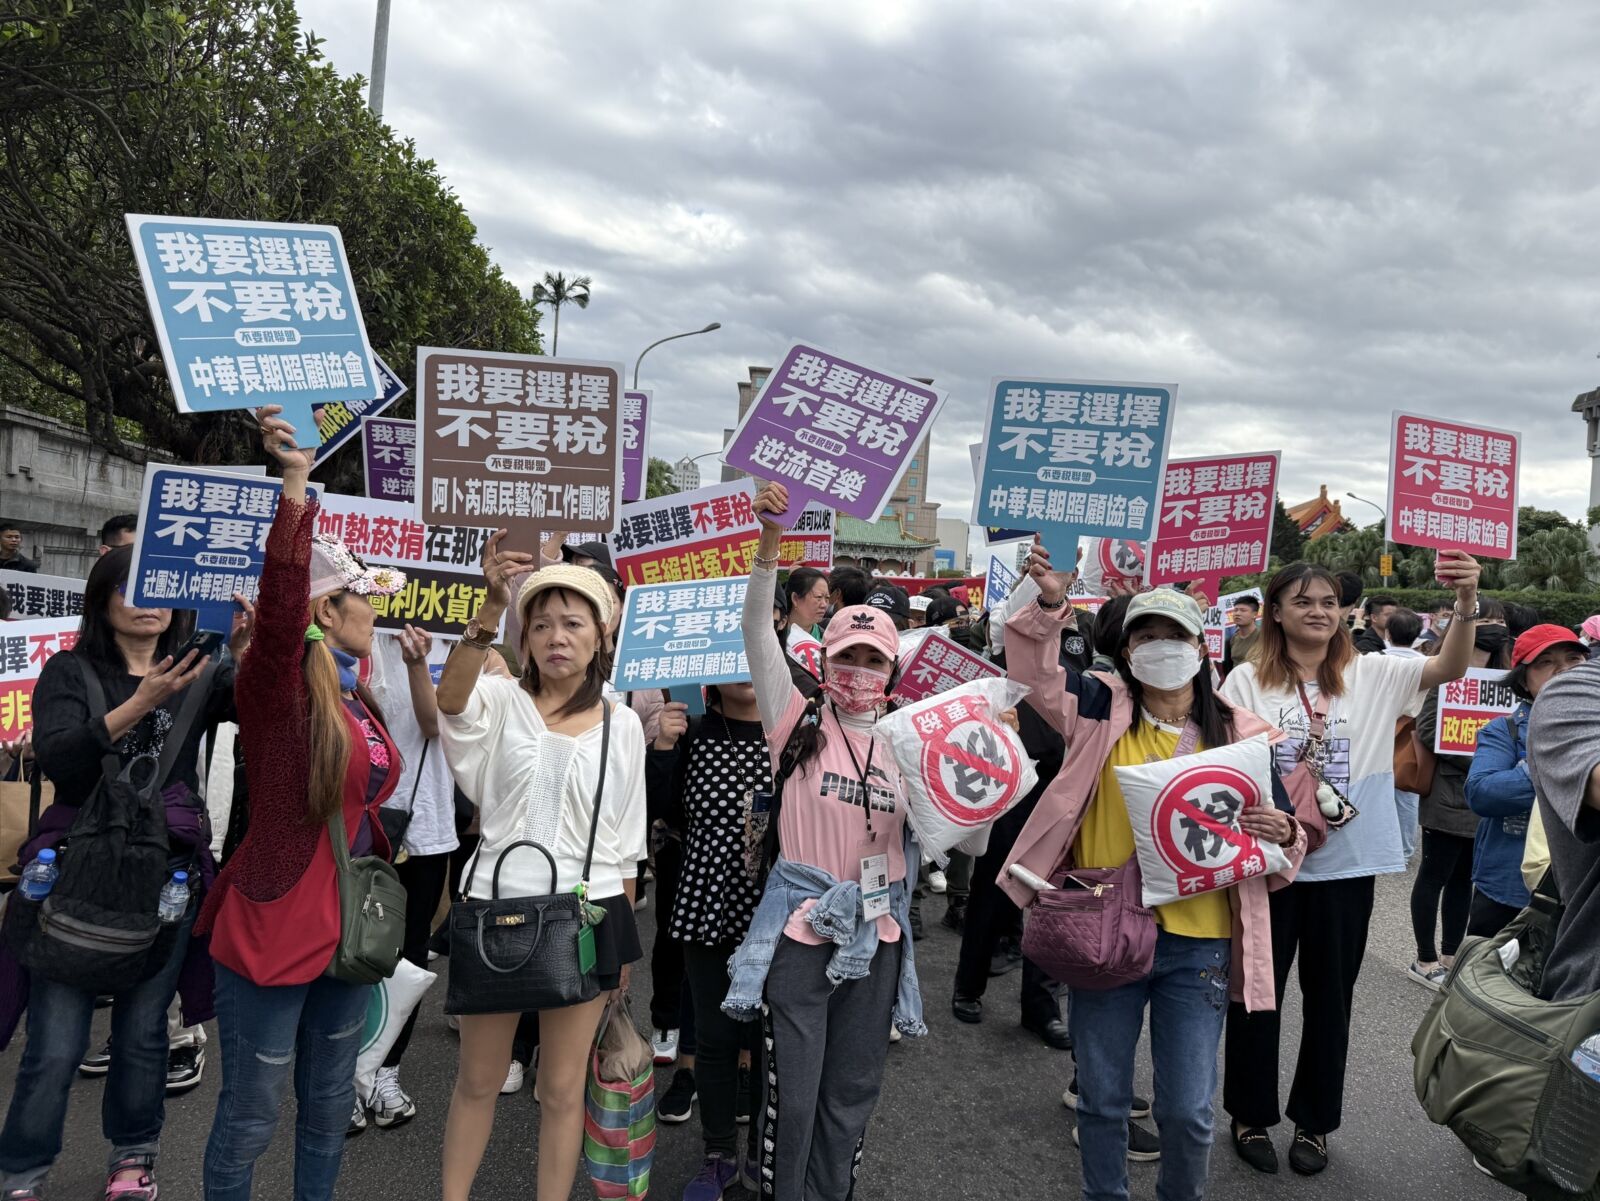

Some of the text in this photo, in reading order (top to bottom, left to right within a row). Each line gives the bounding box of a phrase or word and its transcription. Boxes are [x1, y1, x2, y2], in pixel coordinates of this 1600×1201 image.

[154, 231, 338, 277] 我要選擇
[168, 280, 346, 323] 不要稅
[188, 351, 367, 397] 中華長期照顧協會
[436, 362, 610, 412] 我要選擇
[787, 352, 930, 424] 我要選擇
[772, 382, 909, 456] 不要稅
[1003, 387, 1161, 429] 我要選擇
[435, 407, 608, 455] 不要稅
[998, 426, 1155, 468] 不要稅
[1404, 422, 1512, 466] 我要選擇
[749, 435, 866, 502] 逆流音樂
[1165, 461, 1271, 497] 我要選擇
[1401, 455, 1510, 499] 不要稅
[160, 478, 280, 518] 我要選
[431, 476, 611, 521] 阿卜芮原民藝術工作團隊
[988, 484, 1149, 530] 中華長期照顧協會
[1161, 491, 1267, 528] 不要稅
[1399, 506, 1509, 549] 中華民國滑板協會
[1157, 540, 1263, 576] 中華民國滑板協會
[142, 569, 260, 603] 社團法人中華民國身障
[850, 623, 875, 631] adidas
[623, 650, 750, 682] 中華長期照顧協會
[1441, 715, 1492, 745] 政府
[1182, 854, 1264, 892] 不要稅
